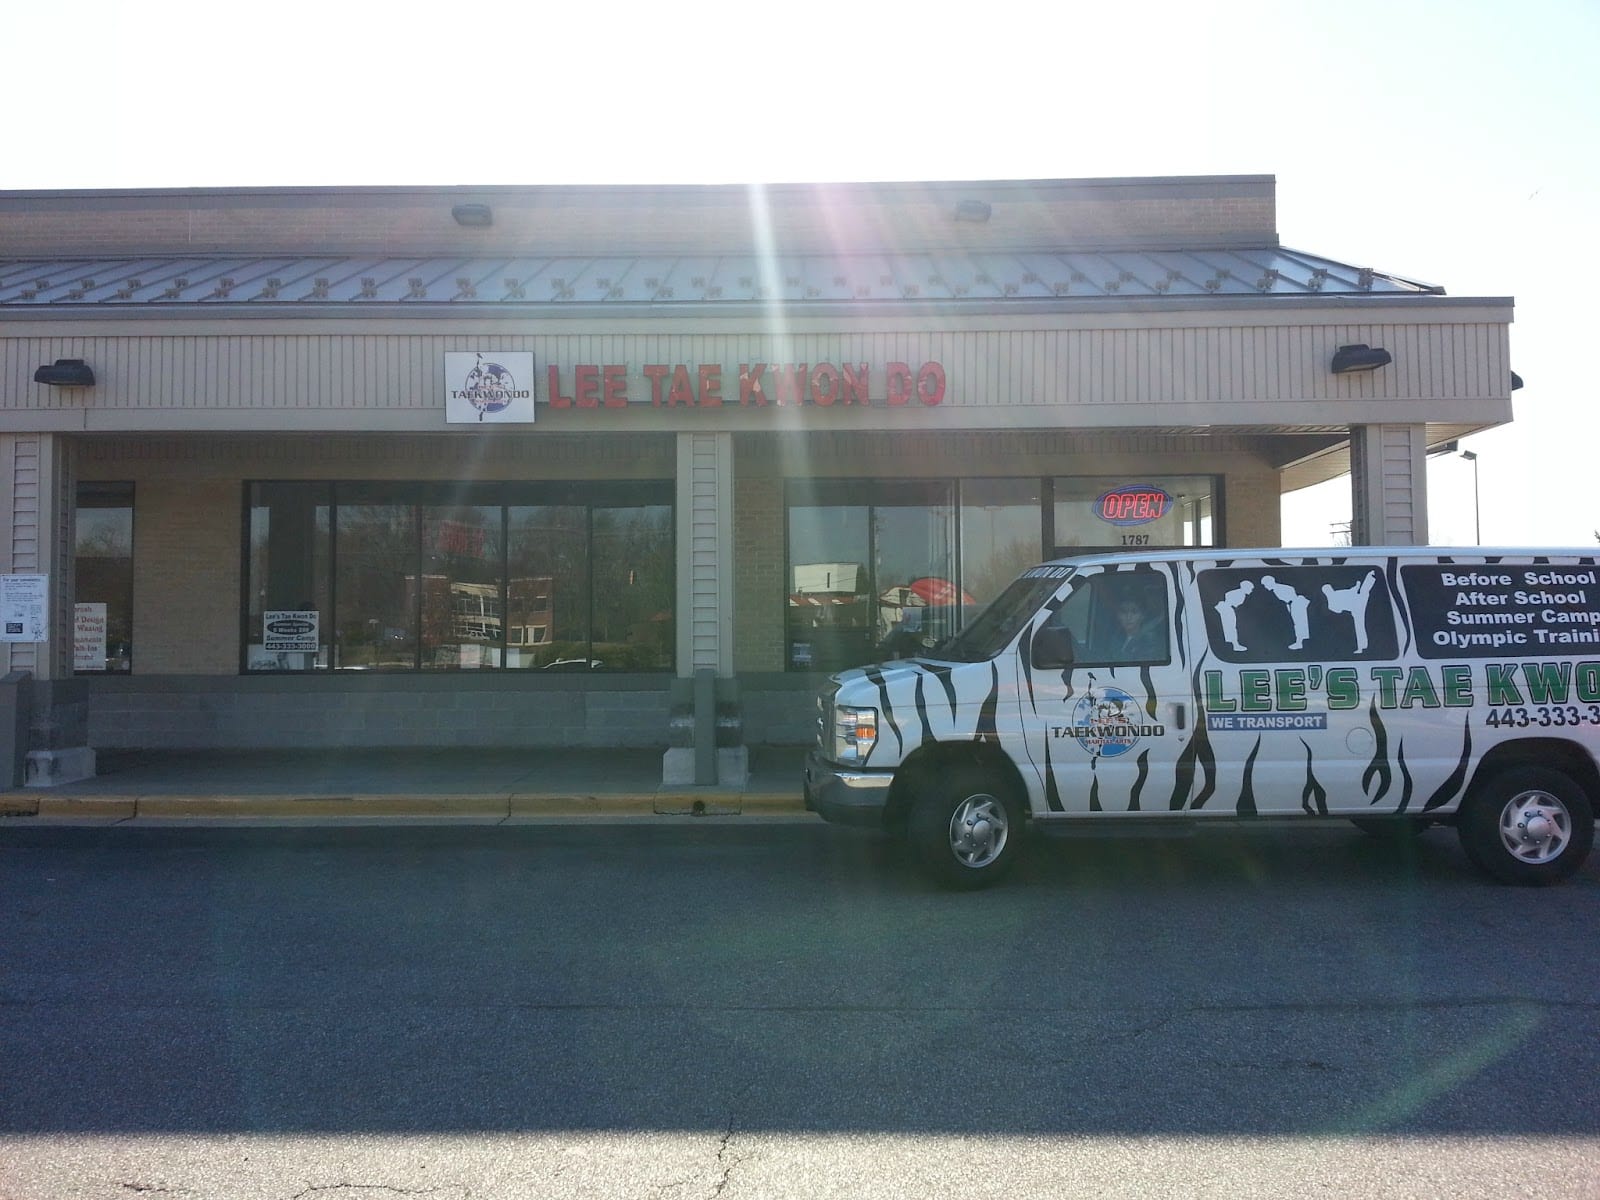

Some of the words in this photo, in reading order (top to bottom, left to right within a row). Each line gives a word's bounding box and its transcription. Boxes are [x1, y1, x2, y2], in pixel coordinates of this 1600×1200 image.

[548, 364, 628, 408] LEE
[643, 364, 722, 408] TAE
[739, 362, 869, 408] KWON
[886, 361, 946, 407] DO
[451, 391, 529, 399] TAEKWONDO
[1103, 493, 1164, 519] OPEN
[1121, 535, 1149, 546] 1787
[1441, 573, 1512, 586] Before
[1524, 571, 1596, 585] School
[1456, 592, 1508, 605] After
[1514, 590, 1586, 604] School
[1447, 611, 1535, 625] Summer
[1541, 609, 1600, 625] Camp
[1433, 630, 1527, 648] Olympic
[1205, 665, 1359, 712] LEE'S
[1371, 664, 1474, 709] TAE
[1485, 661, 1600, 706] KWO
[1211, 717, 1233, 728] WE
[1237, 716, 1322, 728] TRANSPORT
[1486, 705, 1600, 728] 443-333-3
[1051, 725, 1165, 738] TAEKWONDO
